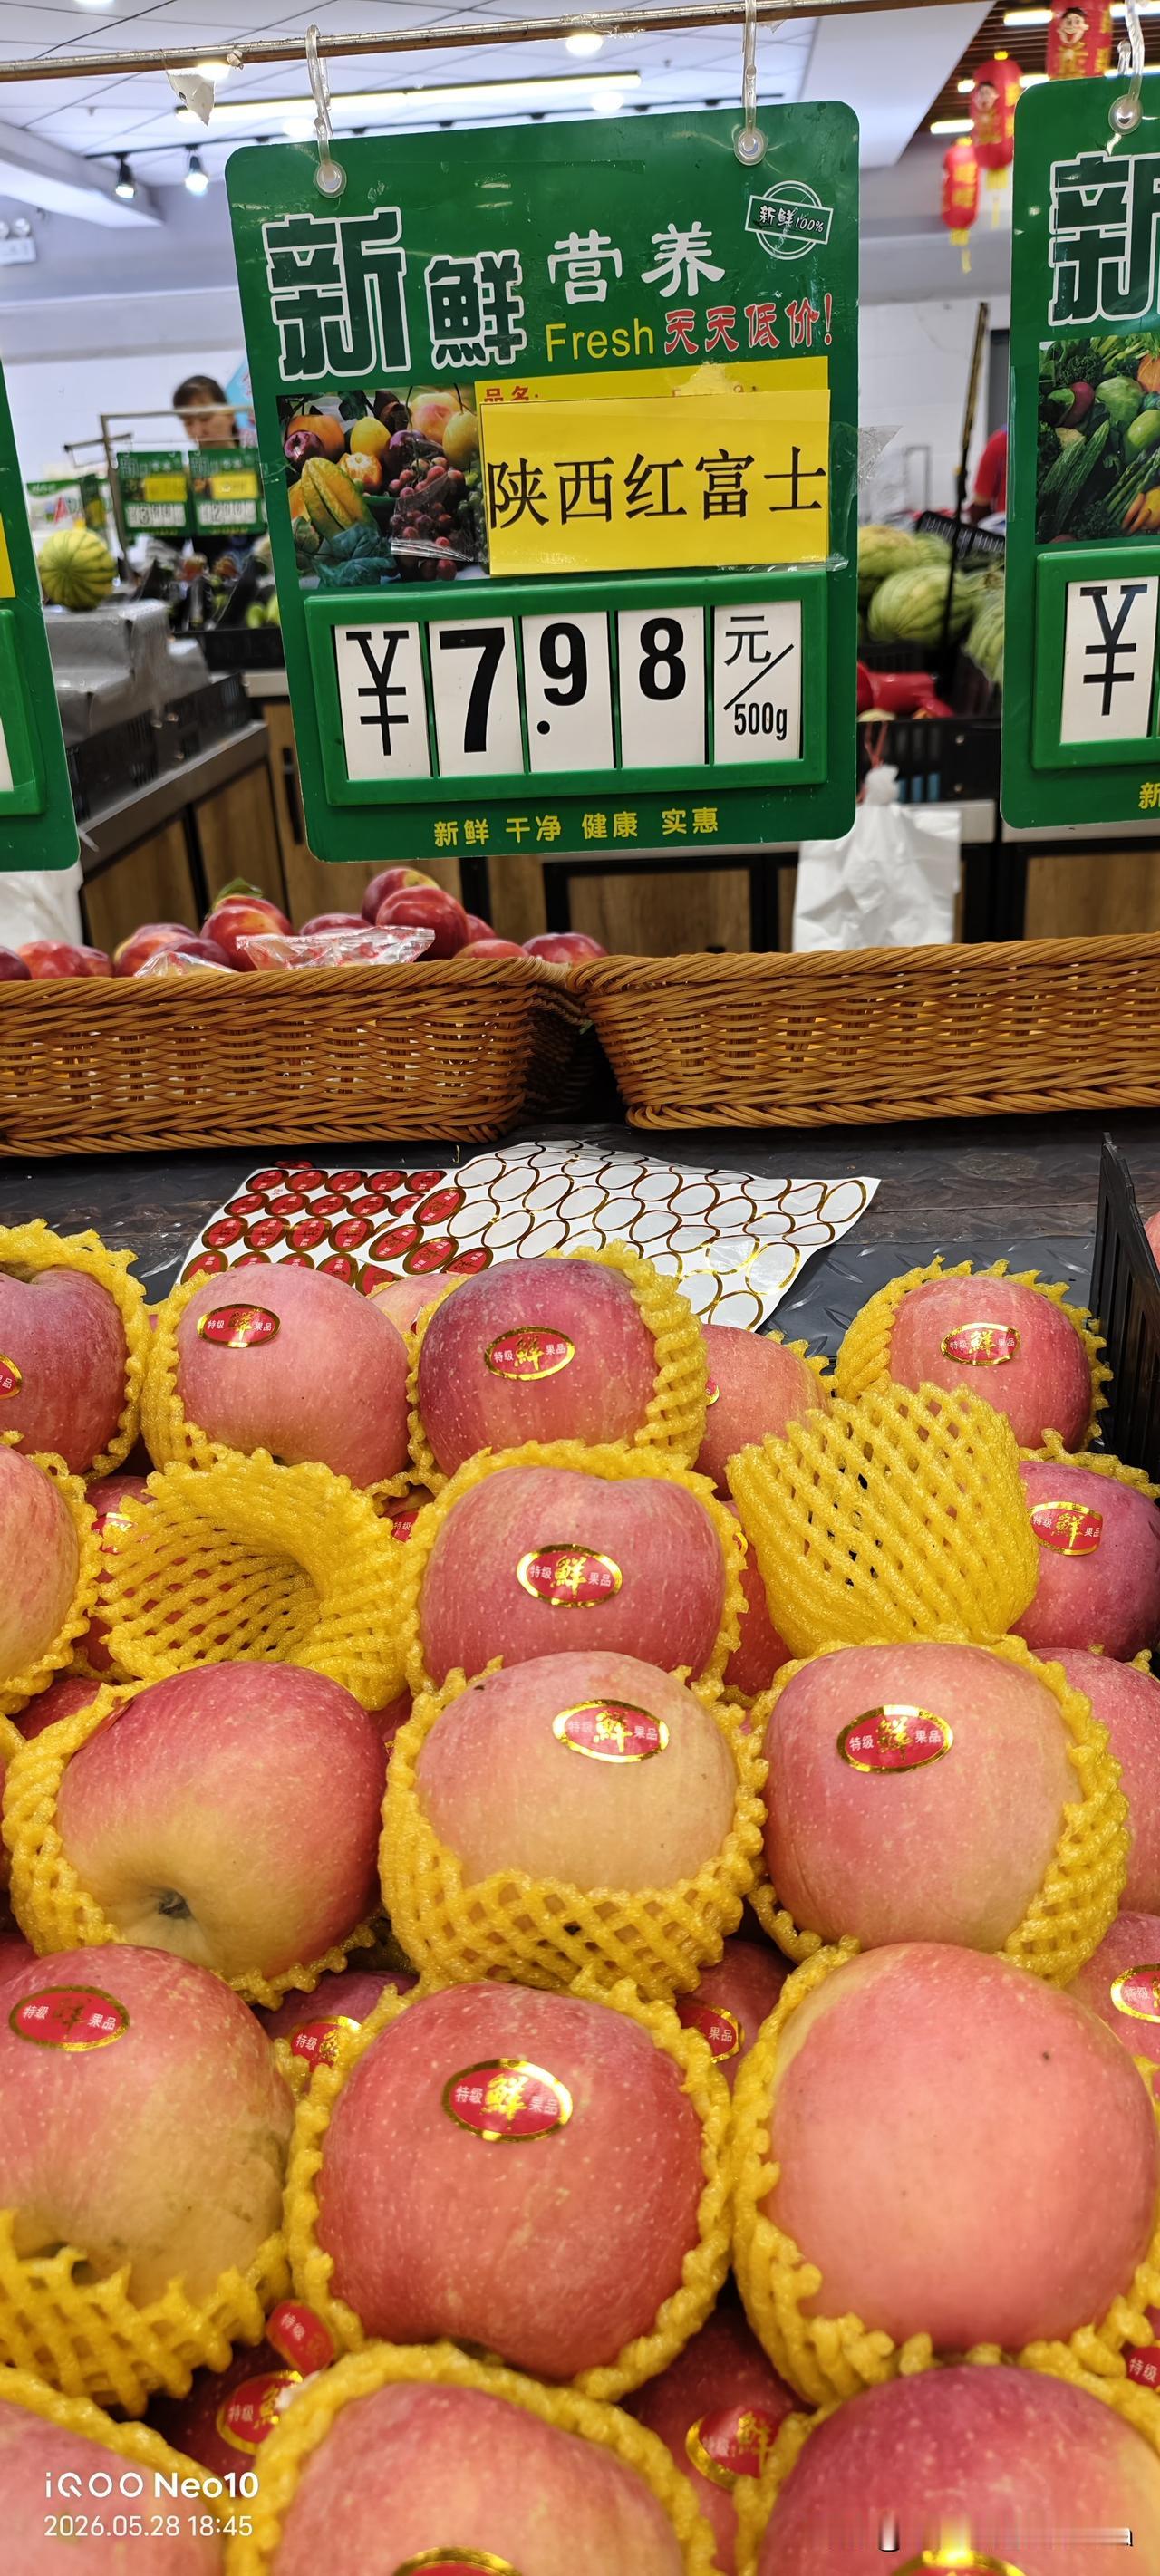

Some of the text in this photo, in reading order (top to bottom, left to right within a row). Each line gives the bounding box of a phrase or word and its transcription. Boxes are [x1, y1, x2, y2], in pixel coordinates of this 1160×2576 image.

[547, 220, 725, 303] 营养
[546, 319, 653, 361] Fresh
[487, 447, 827, 530] 陕西红富士
[433, 807, 720, 847] 新鲜 干净 健康 实惠
[295, 2033, 317, 2051] 特级
[709, 2026, 732, 2042] 果品
[1129, 2357, 1157, 2382] 特级
